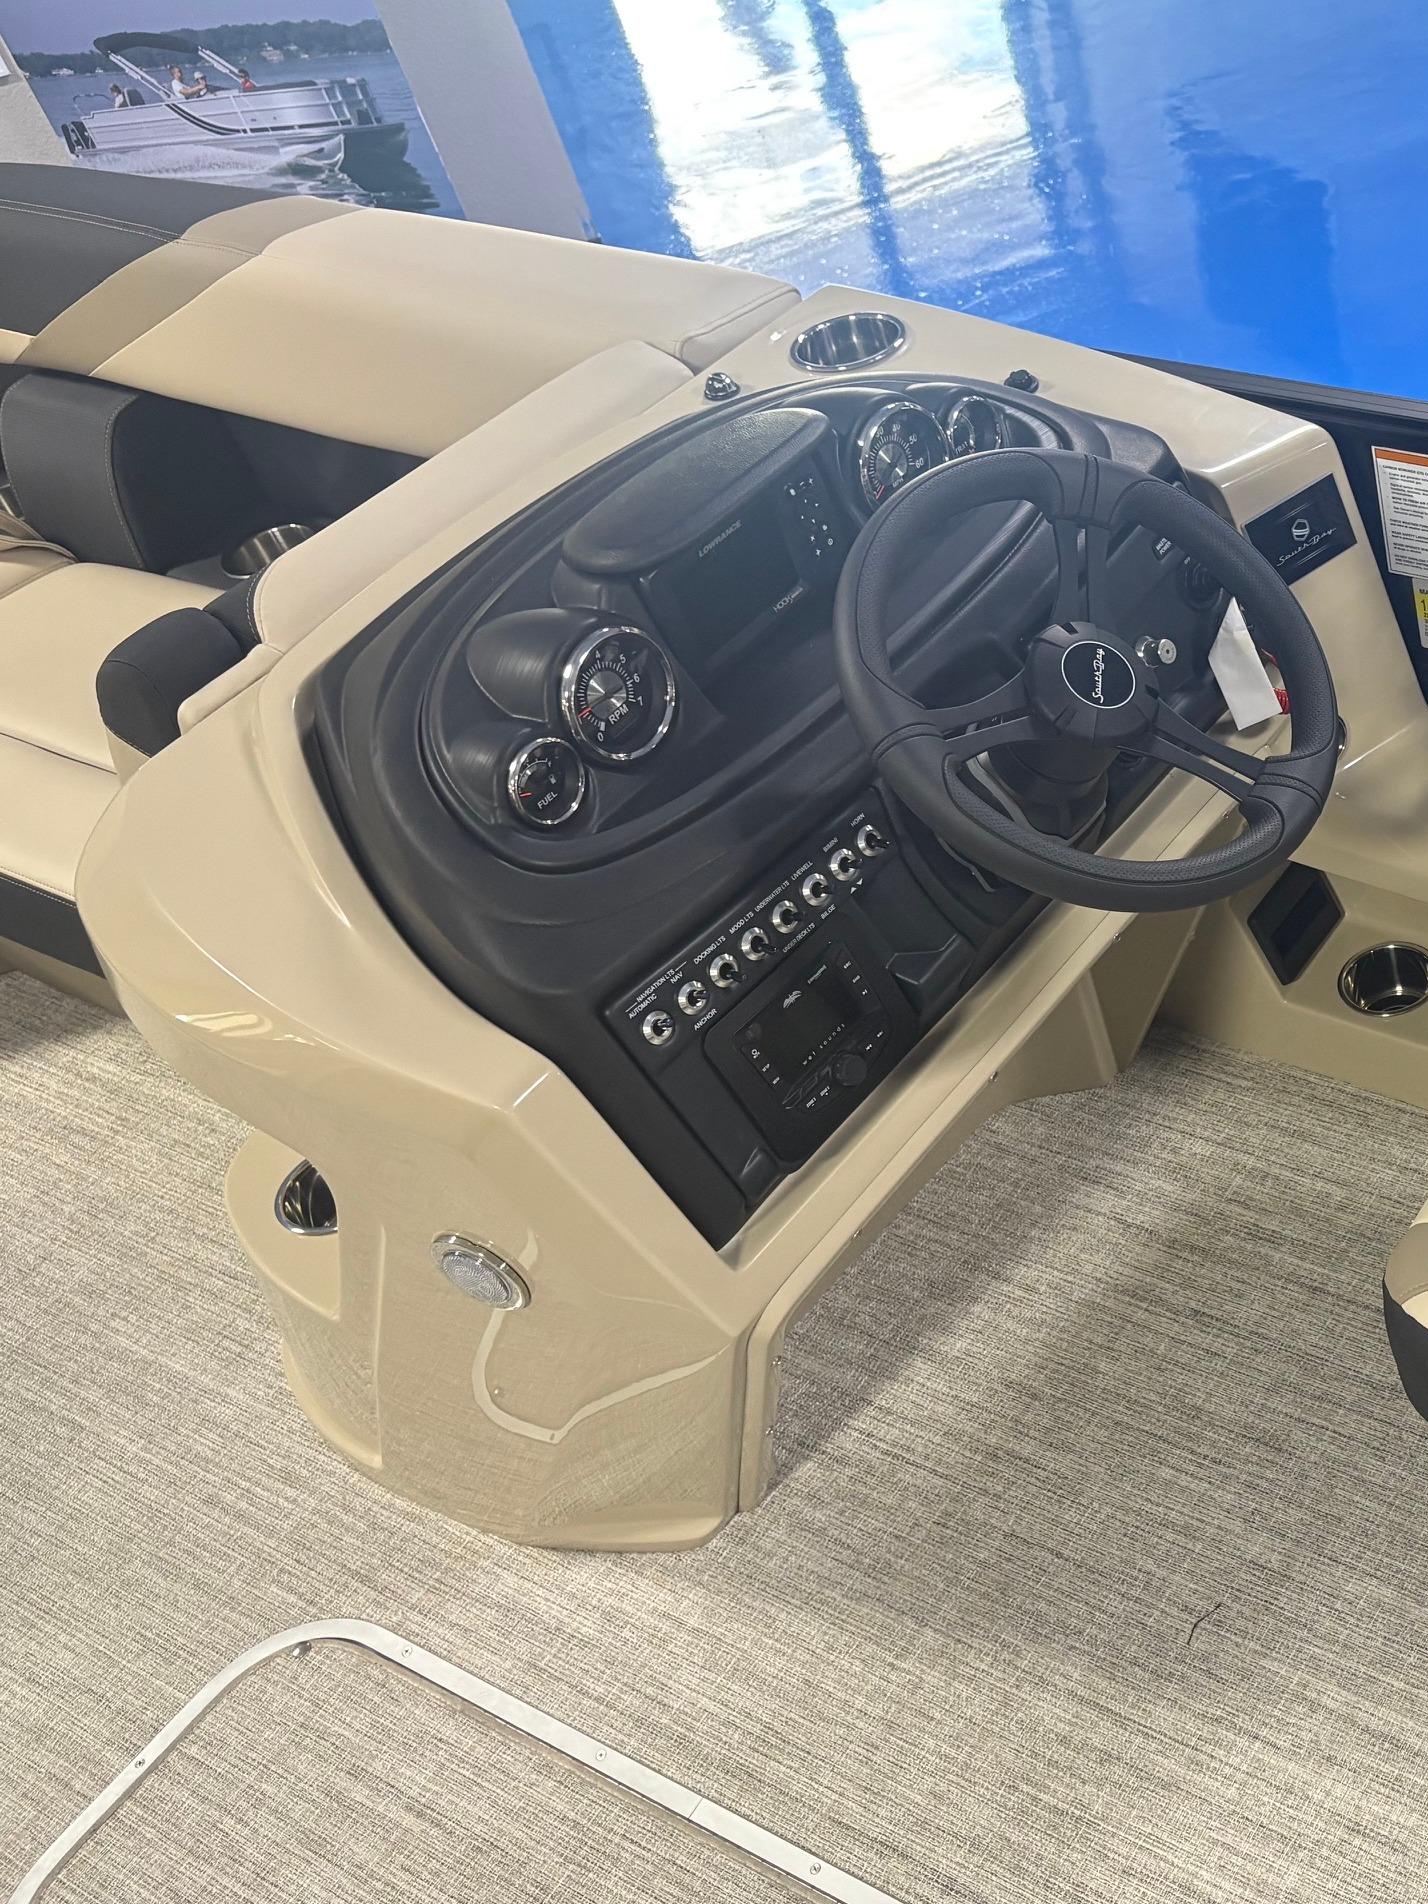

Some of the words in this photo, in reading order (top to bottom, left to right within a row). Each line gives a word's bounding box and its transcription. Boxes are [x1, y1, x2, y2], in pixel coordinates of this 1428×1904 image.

[915, 457, 924, 469] 60
[698, 519, 742, 558] LOWRANCE
[619, 654, 626, 664] 5
[633, 673, 640, 683] 6
[637, 696, 644, 706] 7
[608, 703, 629, 725] RPM
[597, 732, 604, 742] 0
[537, 791, 558, 810] FUEL
[850, 812, 866, 828] HORN
[790, 860, 814, 881] LIVEWELL
[754, 885, 782, 913] UNDERWATER
[781, 880, 790, 890] LTS
[820, 903, 837, 920] BILGE
[729, 918, 745, 935] MOOD
[744, 911, 754, 922] LTS
[782, 936, 798, 953] UNDER
[796, 928, 809, 942] DECK
[807, 922, 816, 933] LTS
[693, 941, 718, 965] DOCKING
[715, 935, 726, 947] LTS
[636, 976, 667, 1003] NAVIGATION
[664, 968, 676, 981] LTS
[670, 971, 684, 984] NAV
[628, 993, 658, 1019] AUTOMATIC
[694, 1008, 719, 1031] ANCHOR
